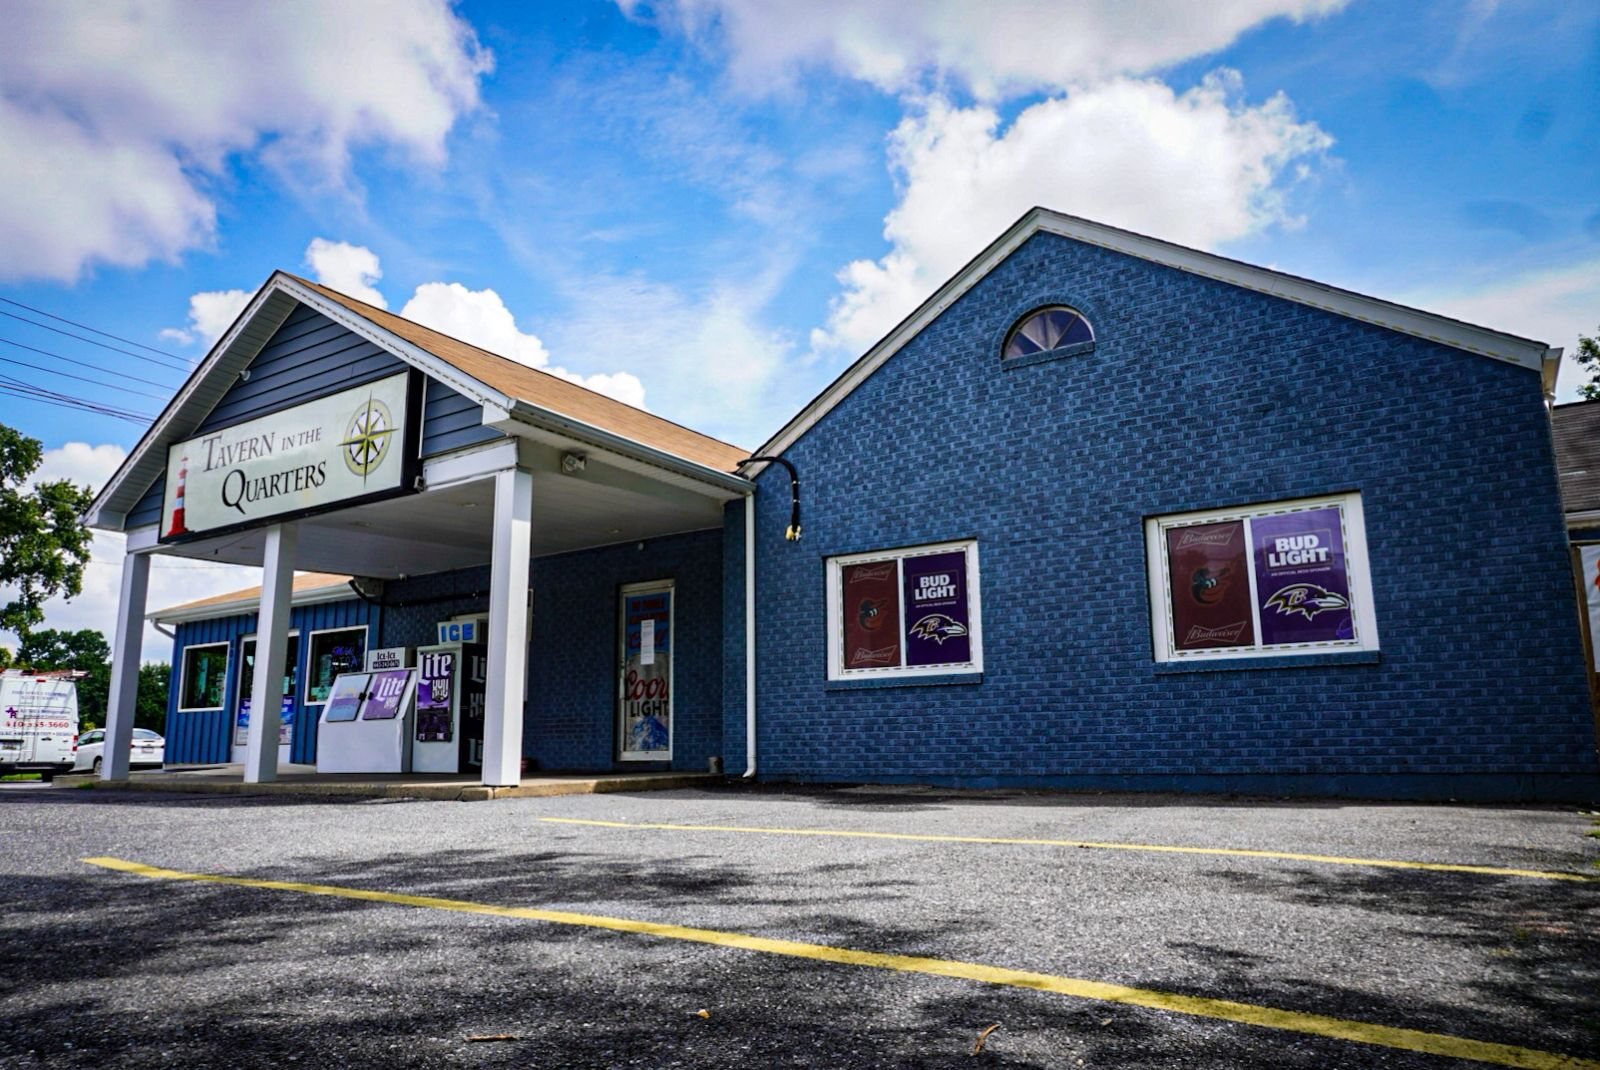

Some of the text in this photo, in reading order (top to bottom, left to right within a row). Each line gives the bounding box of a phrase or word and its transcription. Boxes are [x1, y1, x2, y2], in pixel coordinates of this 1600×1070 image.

[202, 427, 322, 472] TAVERN IN THE
[221, 459, 326, 515] QUARTERS
[1182, 532, 1231, 544] Budweiser
[1275, 534, 1319, 552] BUD
[1268, 547, 1328, 567] LIGHT
[920, 574, 950, 588] BUD
[914, 584, 957, 600] LIGHT
[441, 623, 474, 642] ICE
[1191, 627, 1239, 641] Budweiser
[417, 653, 452, 685] Lite
[470, 656, 486, 684] Li
[375, 677, 405, 702] Lite
[625, 669, 669, 701] Coor
[630, 700, 669, 717] LIGHT
[468, 738, 483, 766] Li
